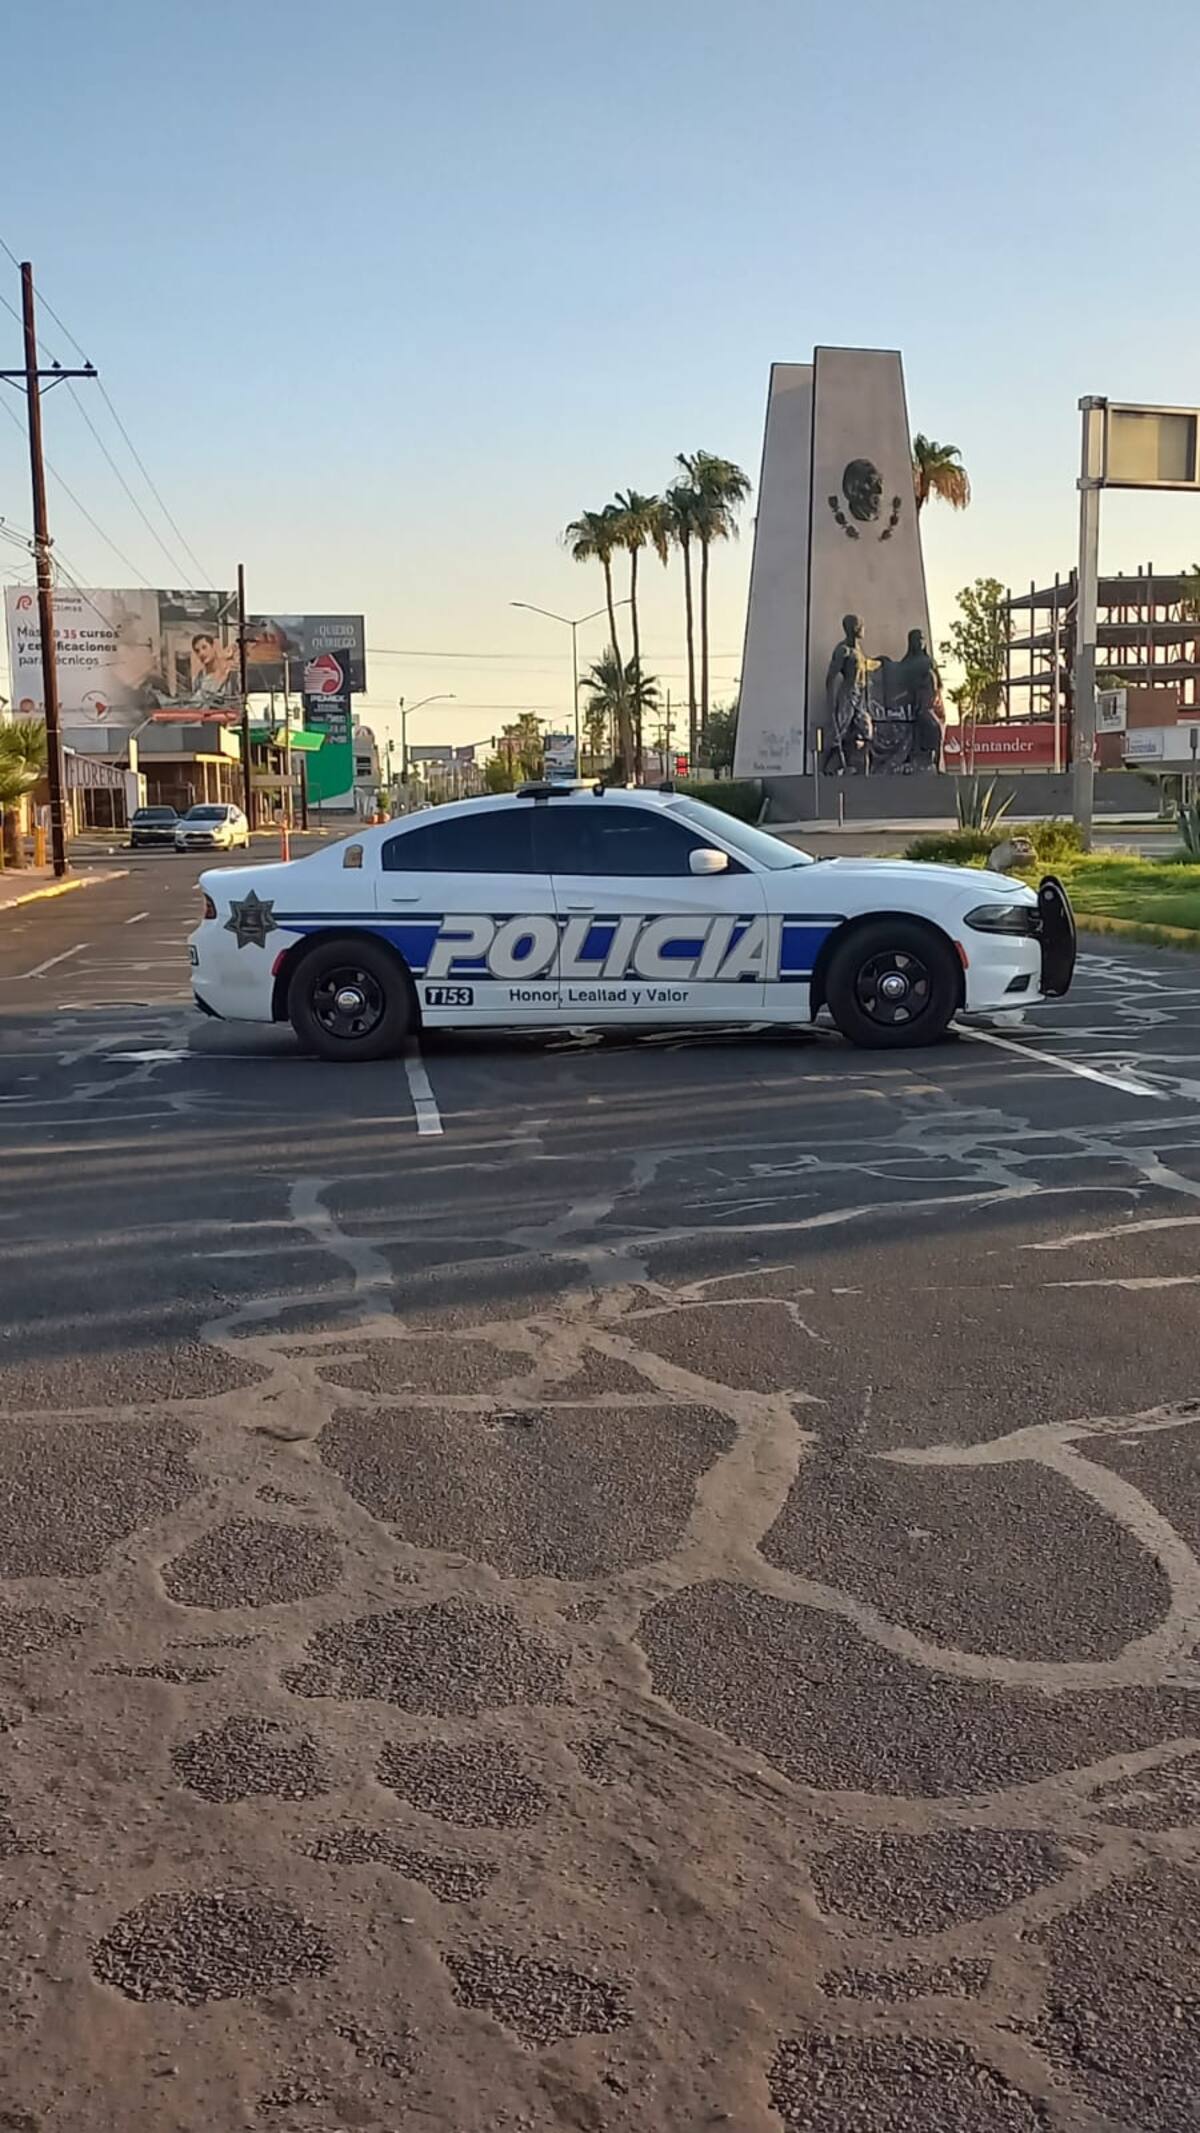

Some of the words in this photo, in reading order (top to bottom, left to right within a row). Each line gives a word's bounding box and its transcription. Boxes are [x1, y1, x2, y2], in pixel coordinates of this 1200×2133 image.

[79, 629, 120, 638] cursos
[17, 643, 25, 653] y
[28, 641, 118, 652] ceficaciones
[19, 656, 42, 667] par
[965, 737, 1034, 753] Santander
[423, 913, 784, 983] POLICIA
[428, 988, 470, 1004] T153
[509, 988, 563, 1004] Honor,
[632, 991, 641, 1005] y
[646, 988, 689, 1002] Valor
